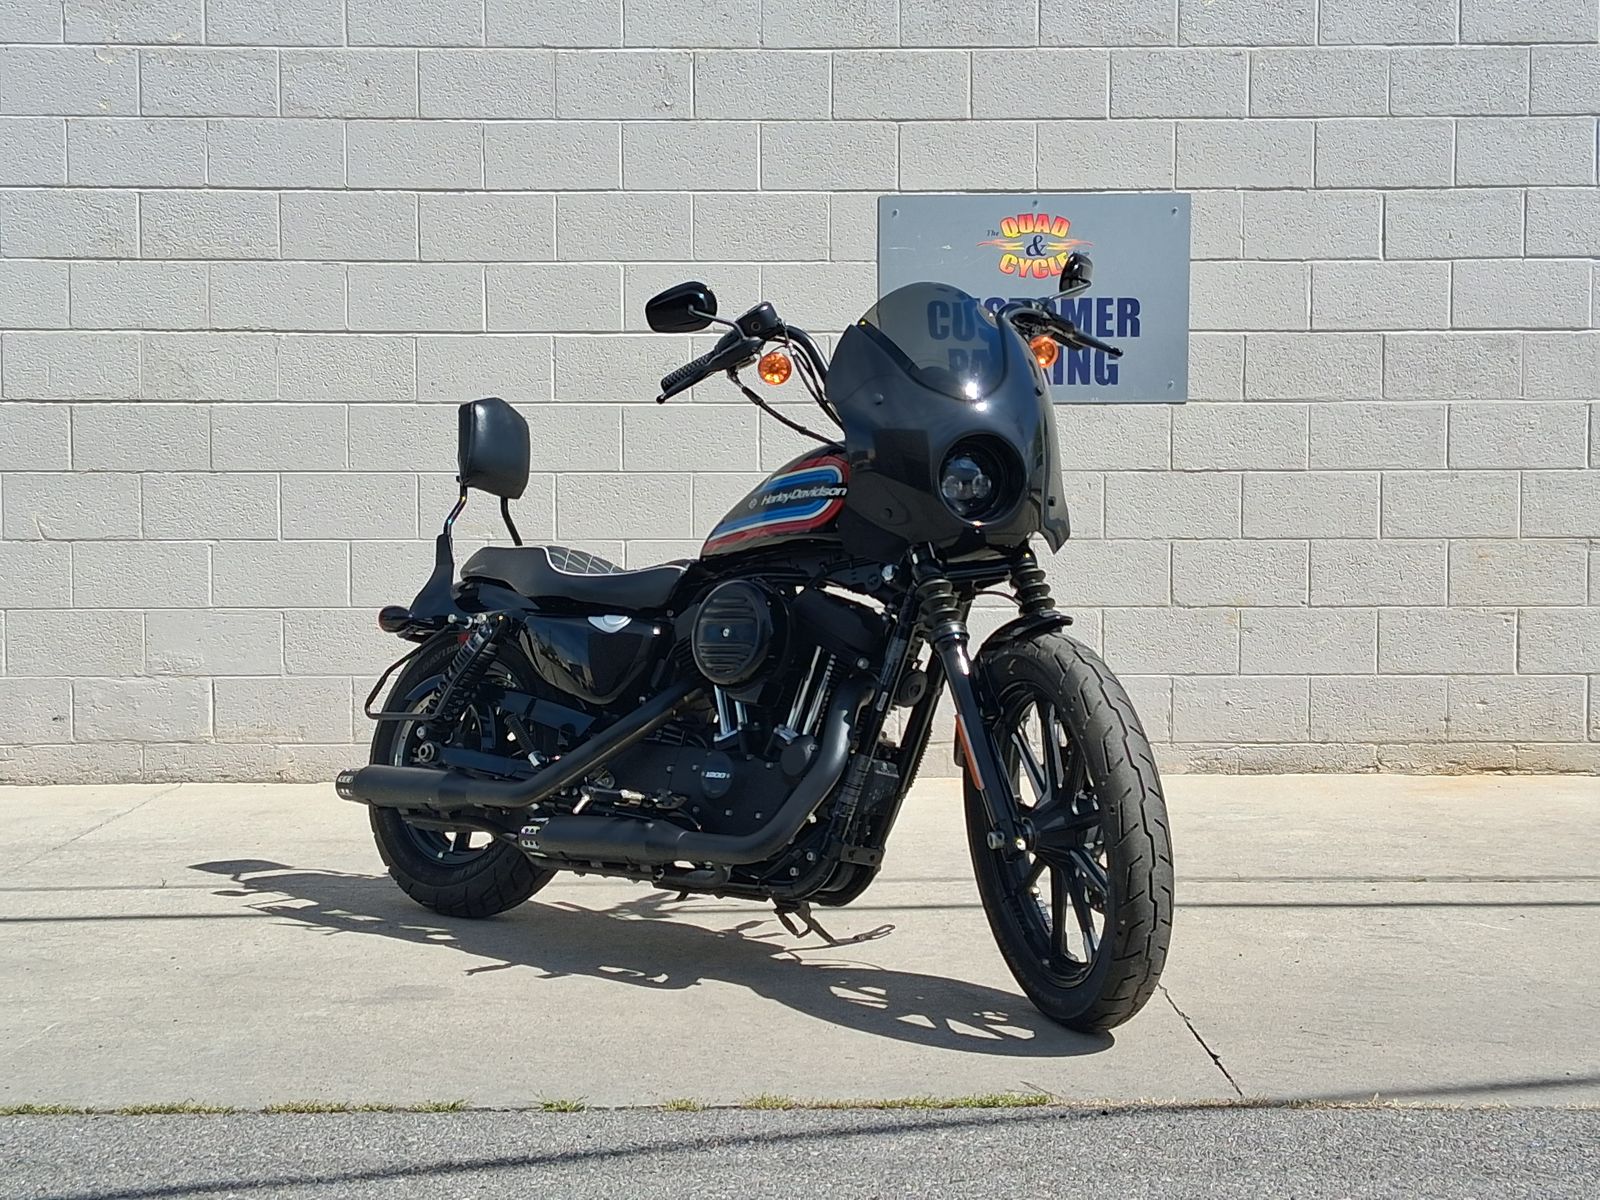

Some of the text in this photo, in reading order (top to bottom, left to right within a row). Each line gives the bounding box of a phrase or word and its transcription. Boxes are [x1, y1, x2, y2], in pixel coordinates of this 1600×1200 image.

[986, 213, 1071, 238] The QUAD
[1026, 234, 1047, 257] &
